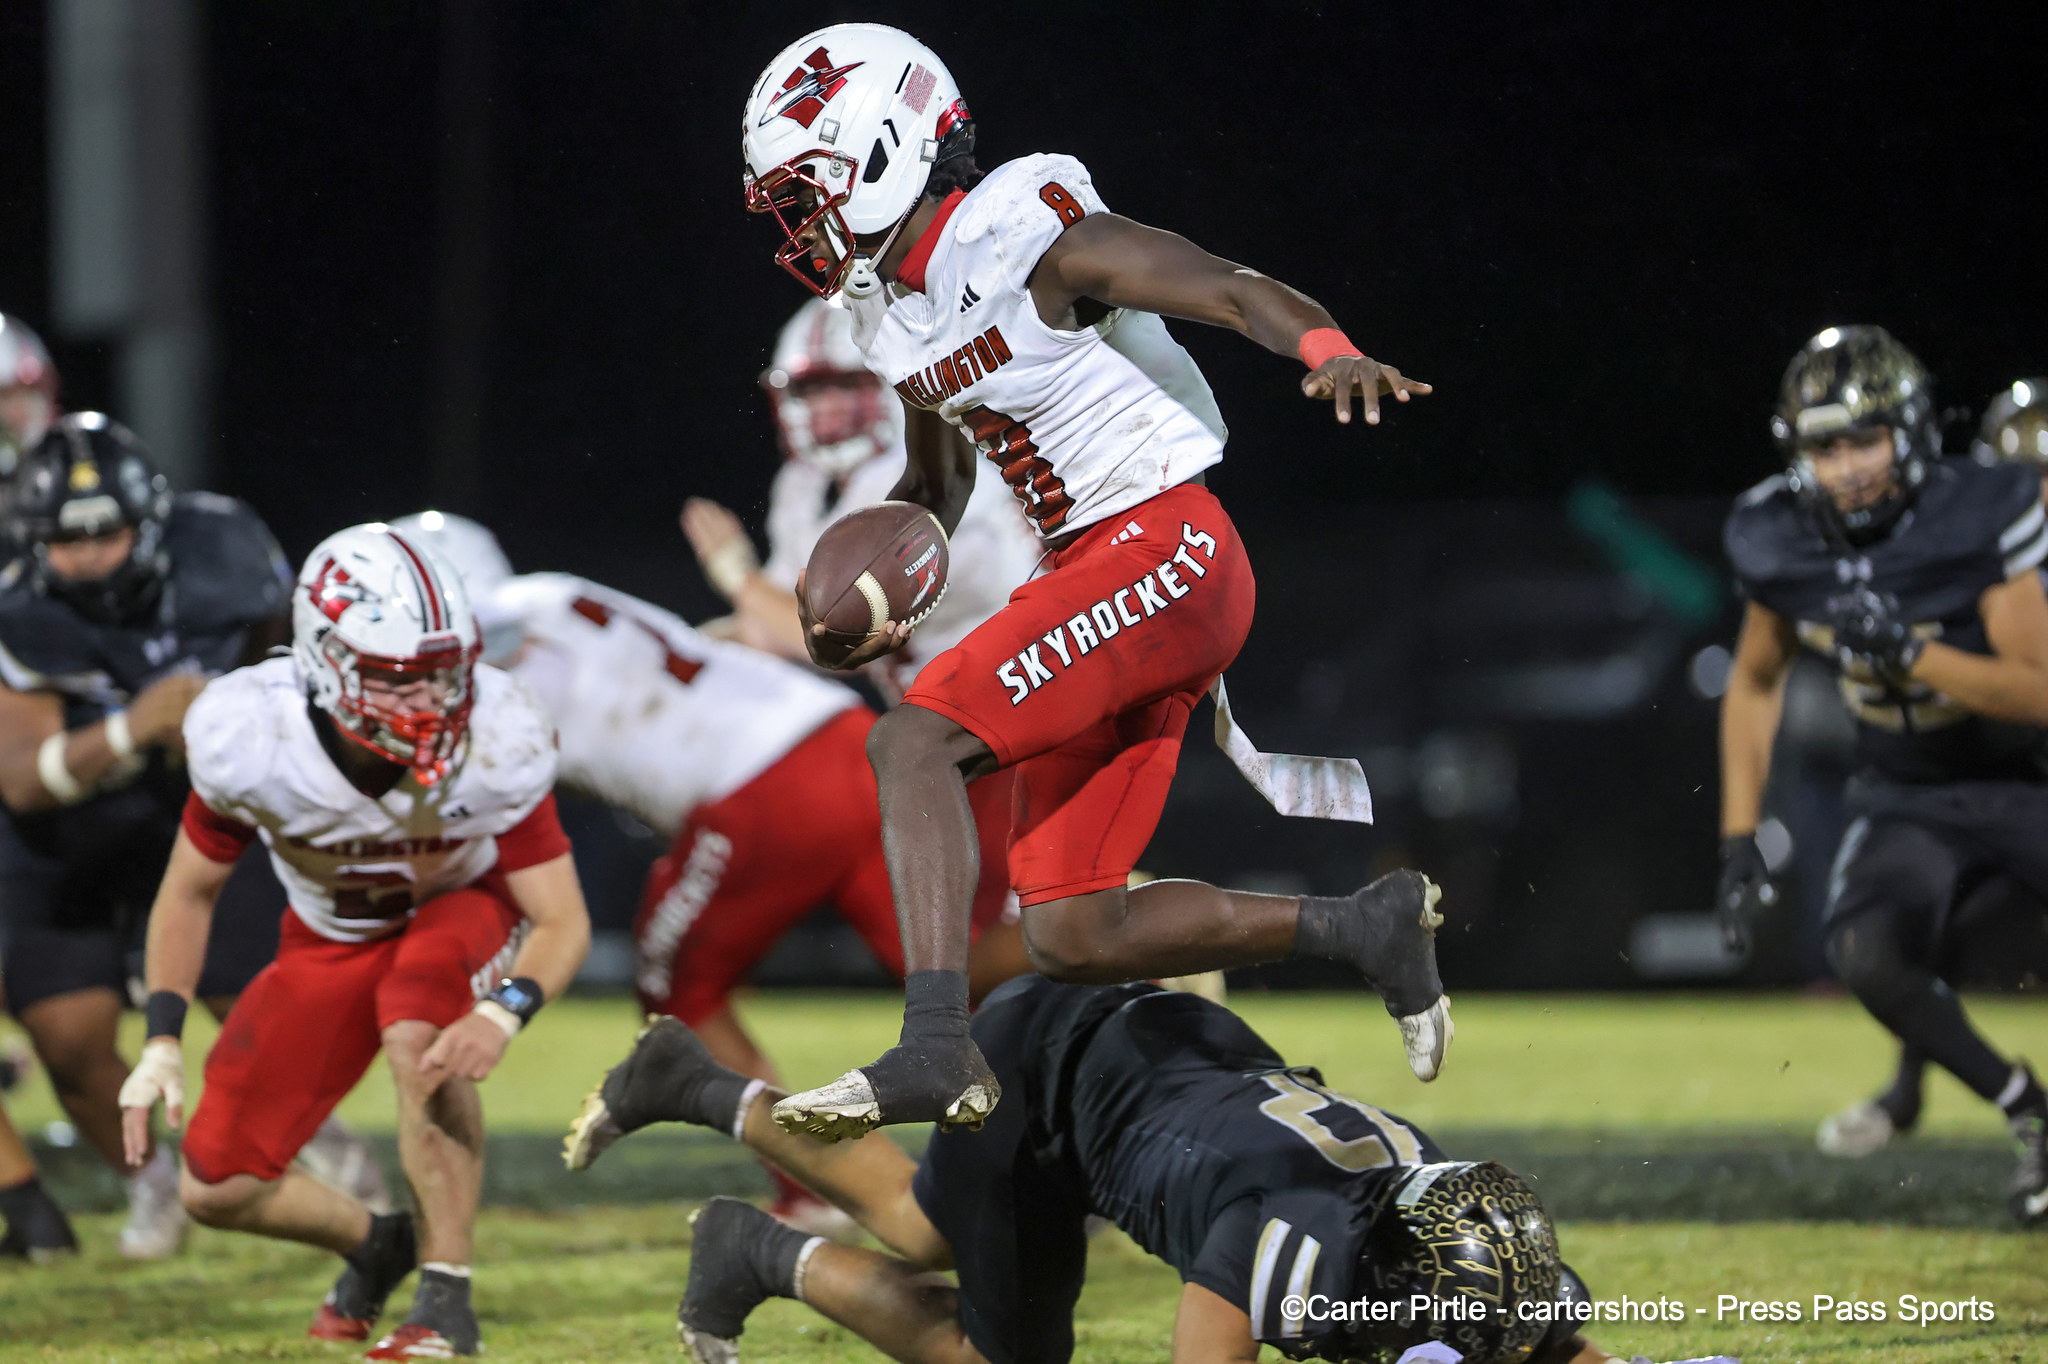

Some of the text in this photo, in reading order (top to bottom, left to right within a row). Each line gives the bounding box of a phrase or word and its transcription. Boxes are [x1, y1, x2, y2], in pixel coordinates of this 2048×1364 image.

[1039, 181, 1086, 231] 8
[961, 403, 1076, 536] 8
[904, 542, 938, 578] SKYROCKETS
[996, 520, 1217, 708] SKYROCKETS
